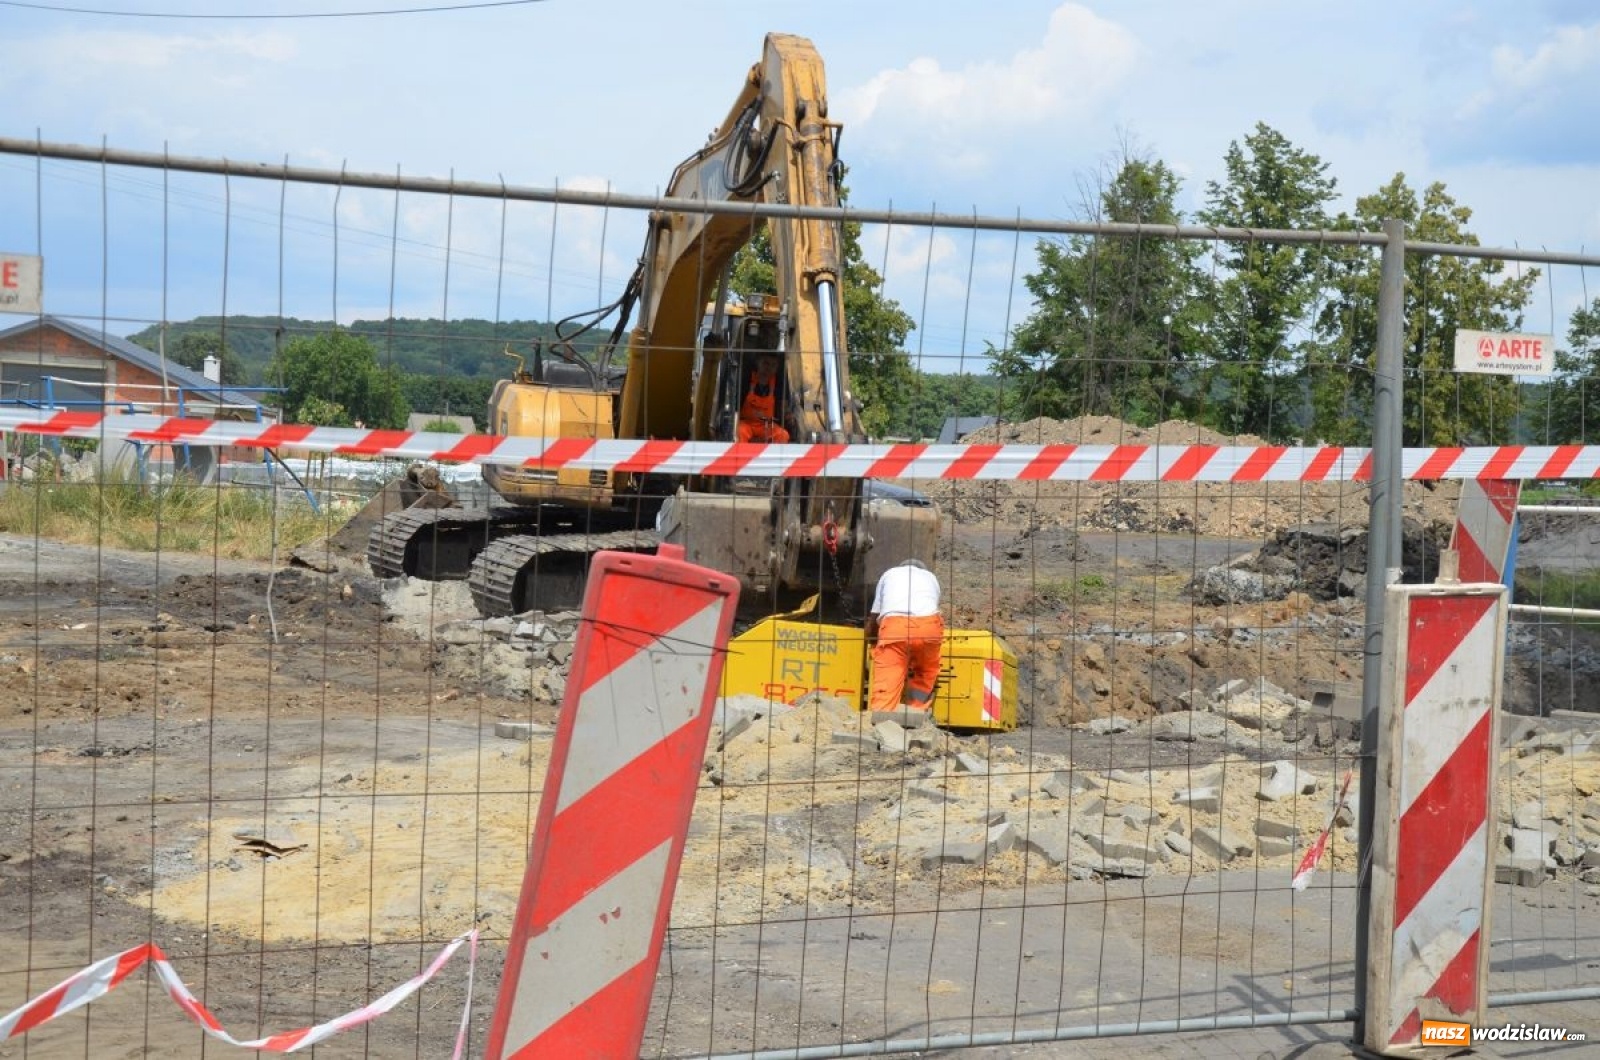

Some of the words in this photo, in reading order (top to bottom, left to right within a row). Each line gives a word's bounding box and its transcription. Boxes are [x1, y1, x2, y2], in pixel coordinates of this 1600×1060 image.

[1498, 339, 1542, 359] ARTE
[1477, 361, 1542, 371] www.artesystem.pl
[776, 628, 837, 643] WACKER
[776, 640, 838, 655] NEUSON
[781, 658, 830, 683] RT
